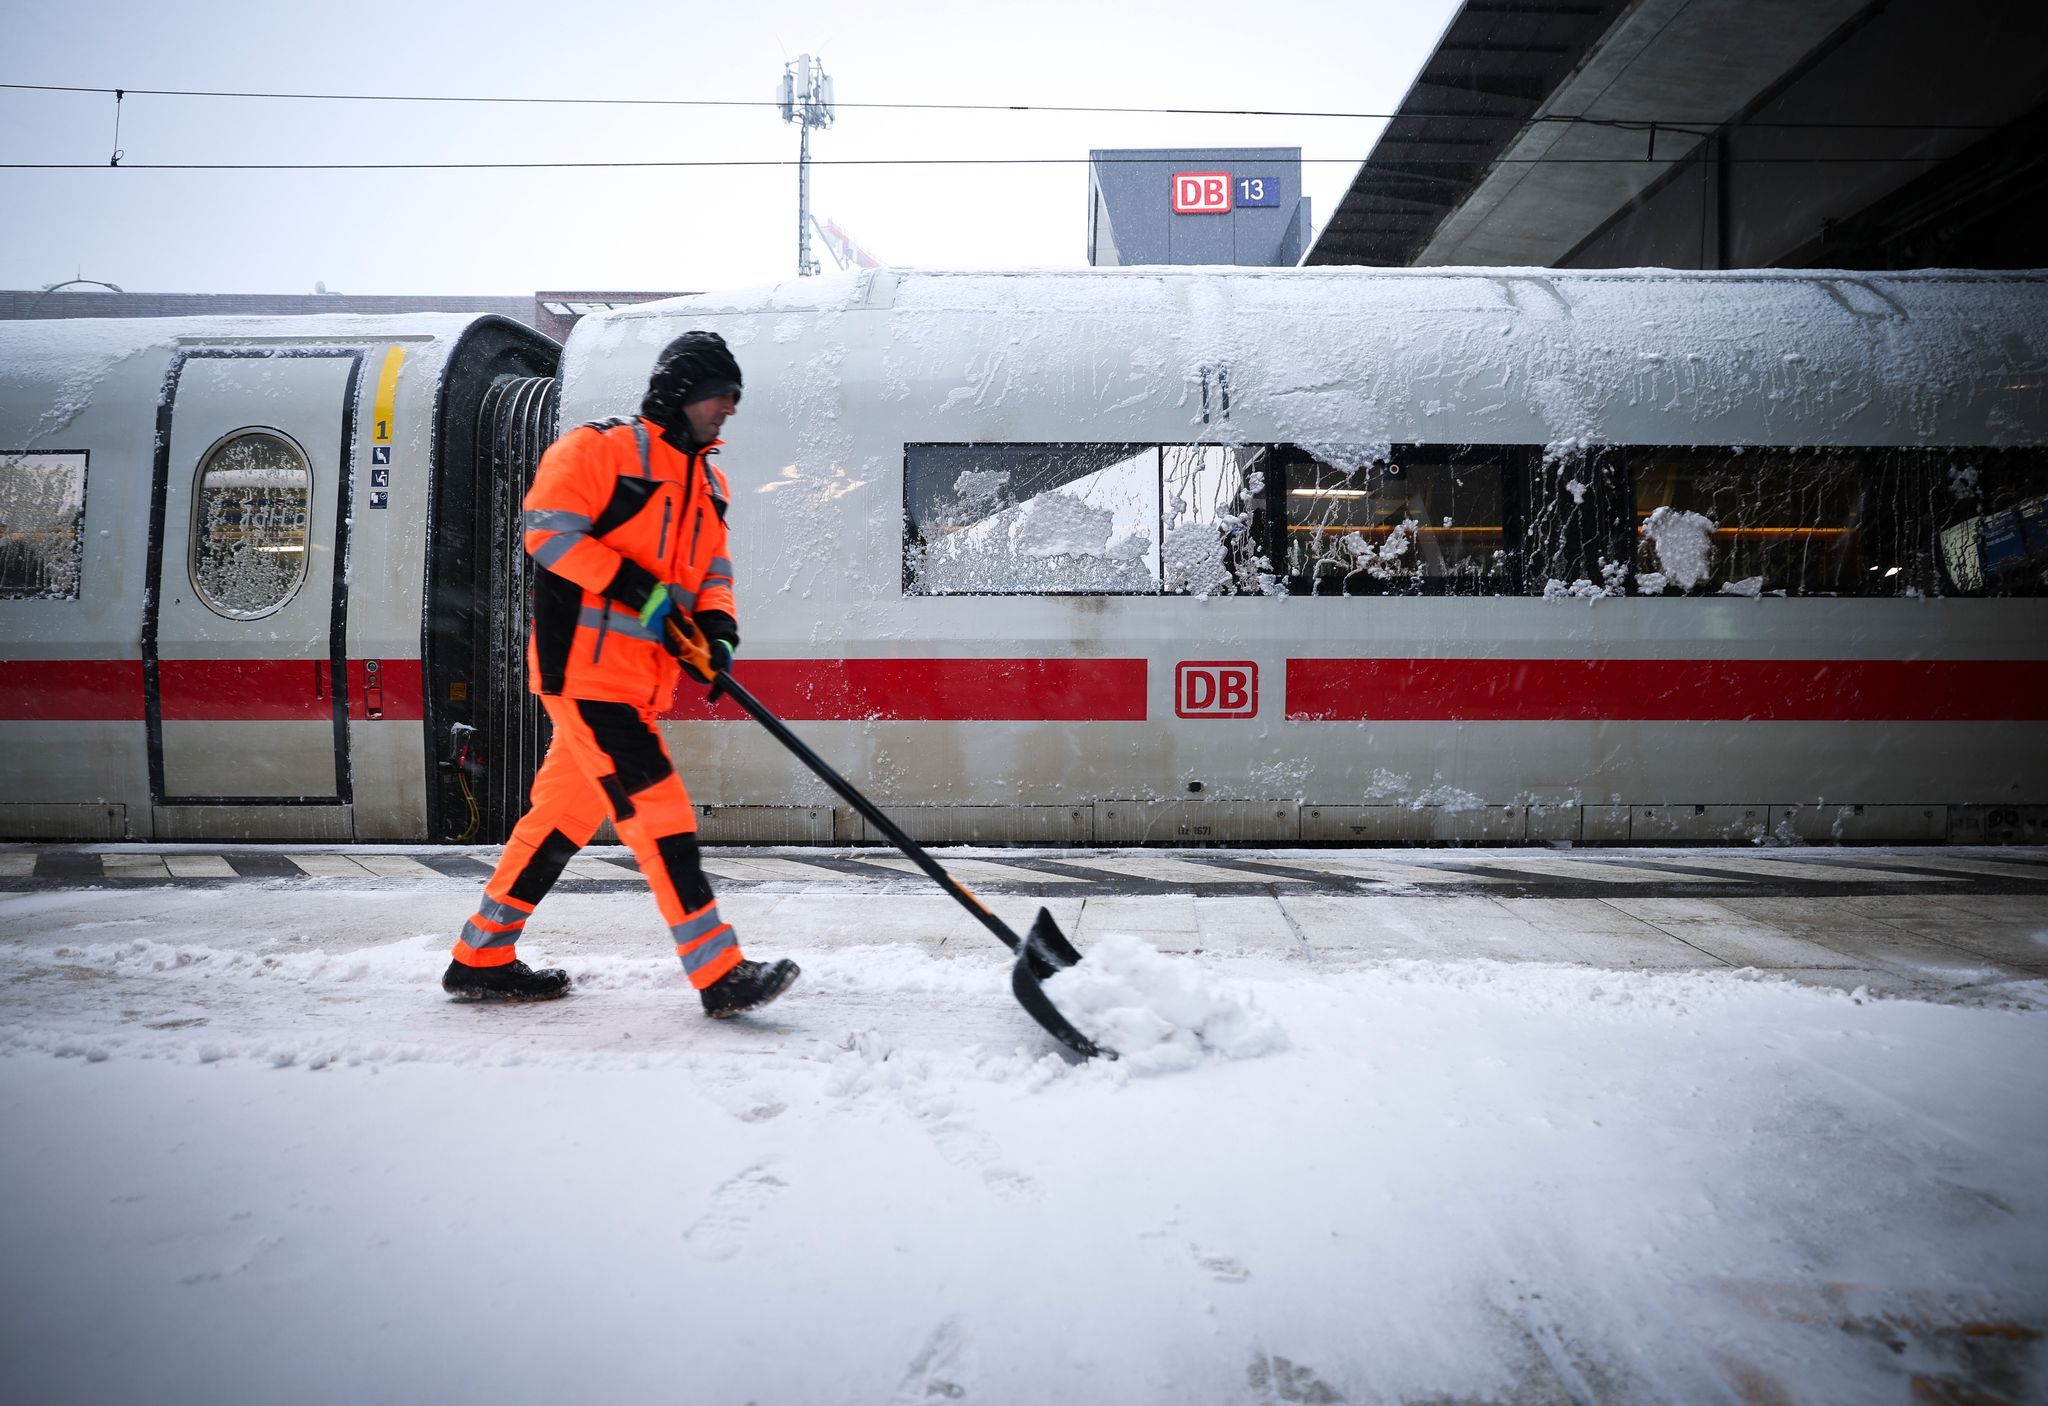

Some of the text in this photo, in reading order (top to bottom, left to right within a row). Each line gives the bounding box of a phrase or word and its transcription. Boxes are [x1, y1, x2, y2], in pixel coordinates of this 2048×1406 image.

[1181, 179, 1224, 206] DB
[1240, 179, 1265, 200] 13
[376, 420, 389, 440] 1
[1186, 670, 1249, 709] DB
